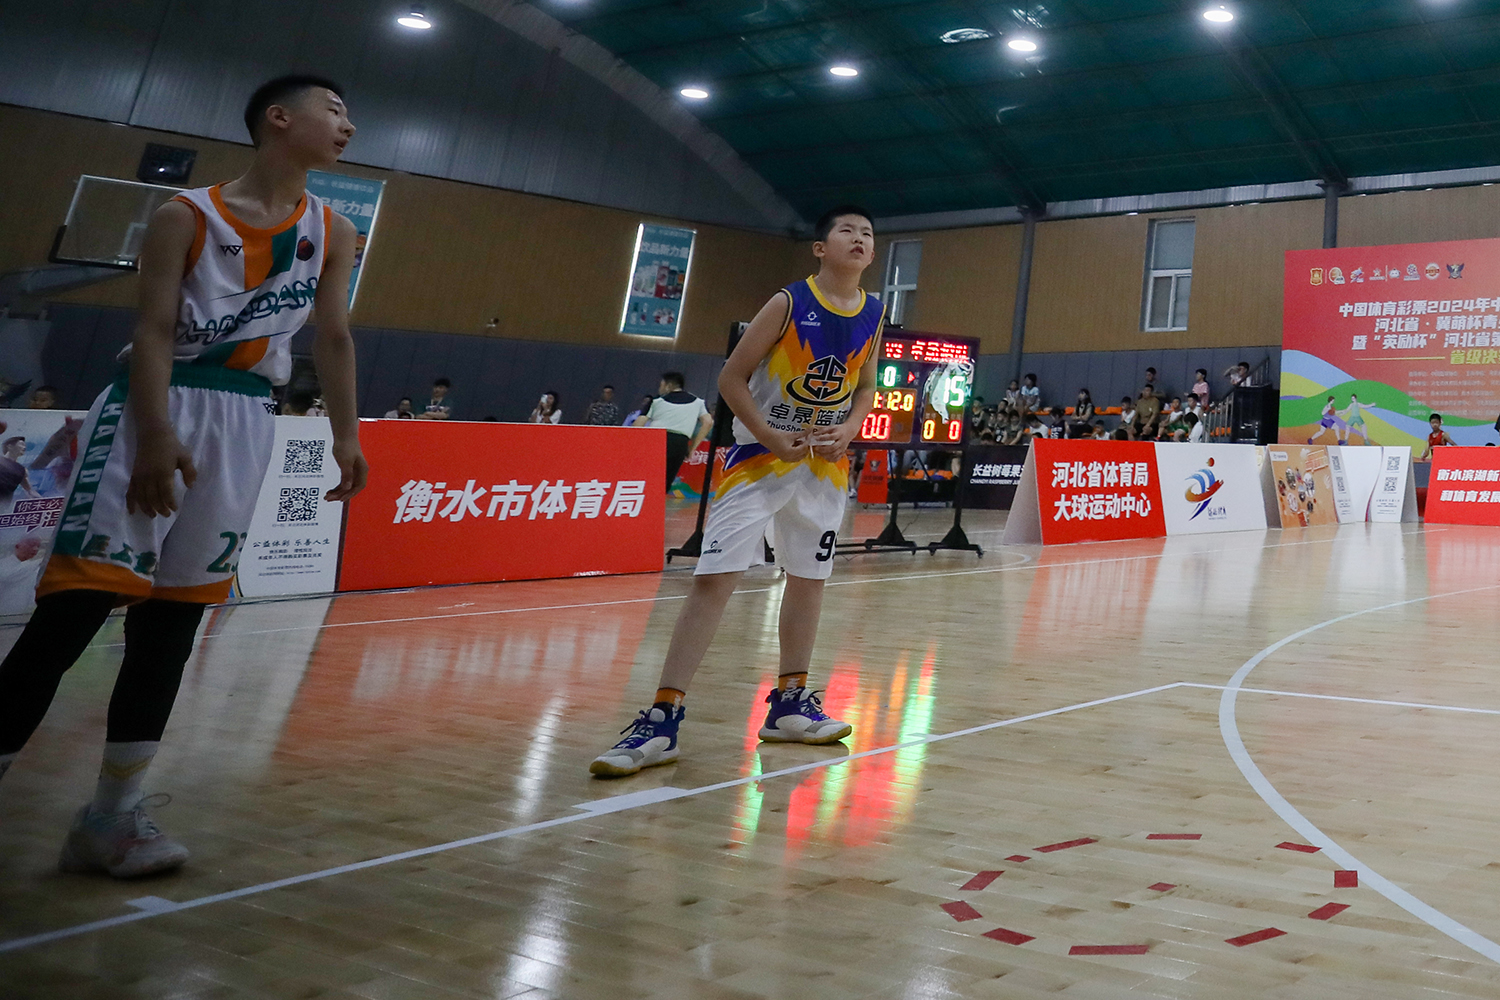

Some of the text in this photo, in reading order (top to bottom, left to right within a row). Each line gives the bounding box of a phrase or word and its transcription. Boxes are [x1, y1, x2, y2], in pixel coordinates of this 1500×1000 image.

[883, 365, 897, 387] 0
[943, 375, 965, 407] 15
[923, 419, 936, 440] 0
[948, 420, 961, 440] 0
[61, 402, 125, 531] HANDAN
[972, 463, 1024, 477] 长益树莓果
[1051, 461, 1149, 488] 河北省体育局
[392, 479, 646, 524] 衡水市体育局
[1053, 491, 1151, 522] 大球运动中心
